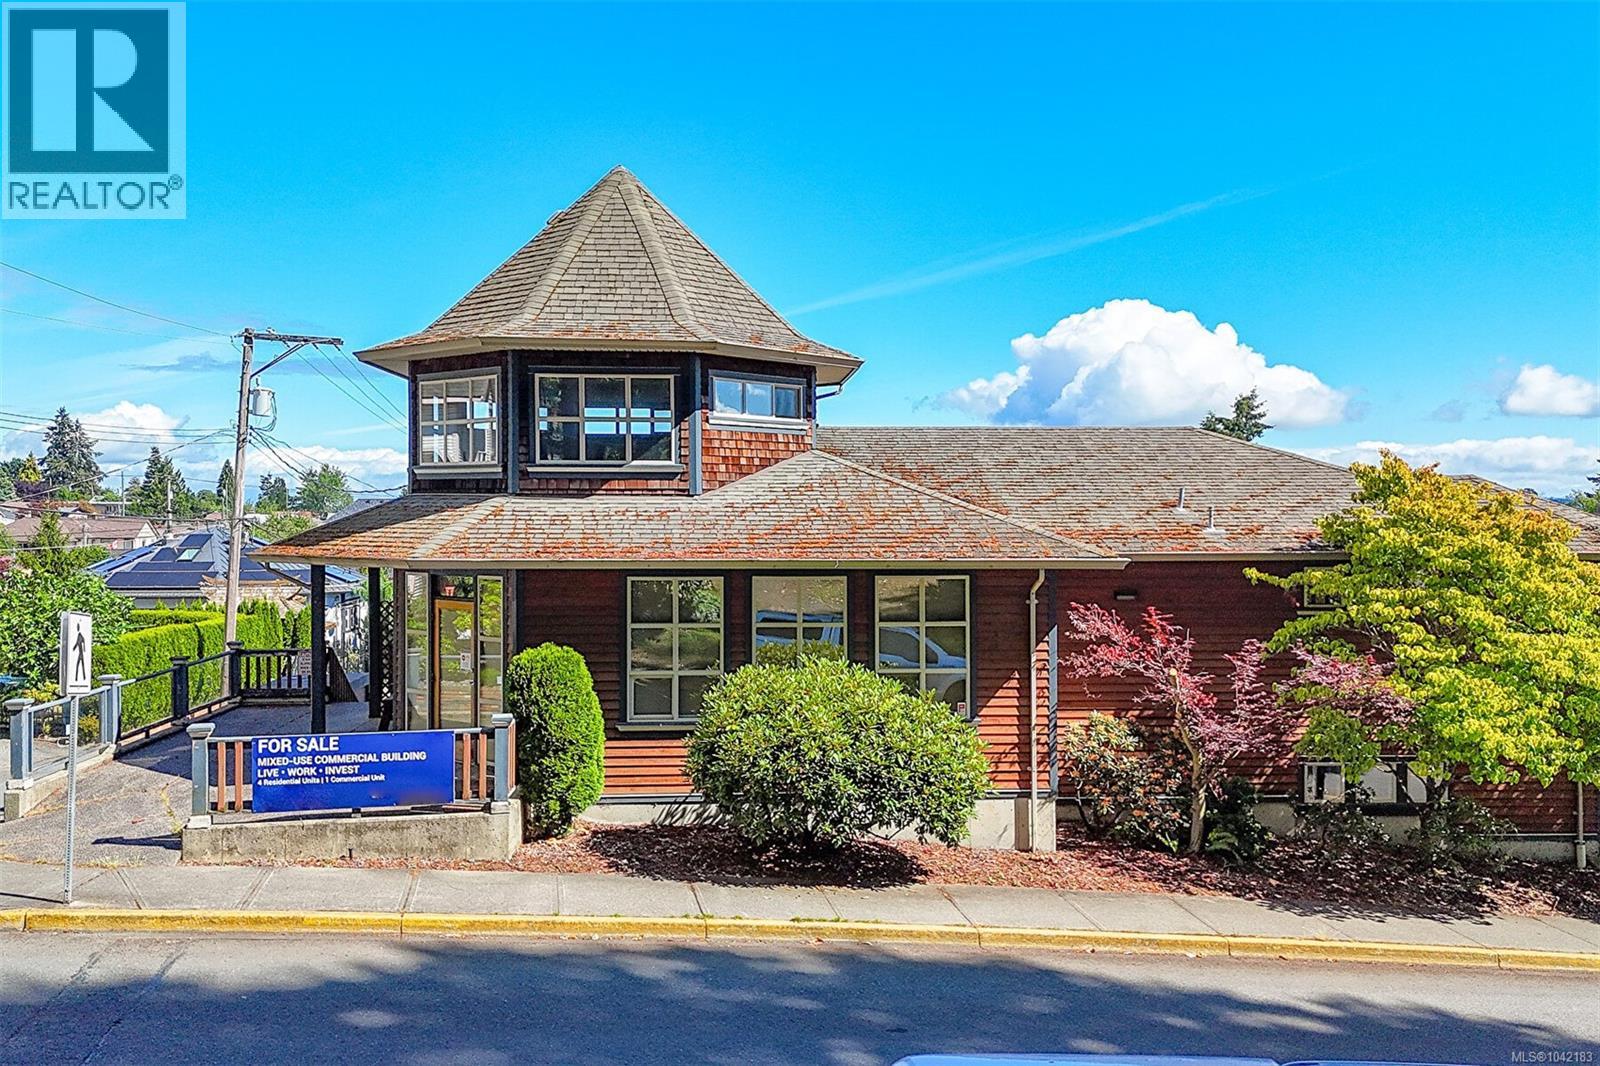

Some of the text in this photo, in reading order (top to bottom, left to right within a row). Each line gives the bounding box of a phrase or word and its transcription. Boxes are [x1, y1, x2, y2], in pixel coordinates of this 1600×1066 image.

[258, 736, 339, 753] FOR SALE
[257, 751, 427, 766] MIXED-USE COMMERCIAL BUILDING
[257, 765, 360, 778] LIVE WORK INVEST
[330, 775, 370, 783] Commercial
